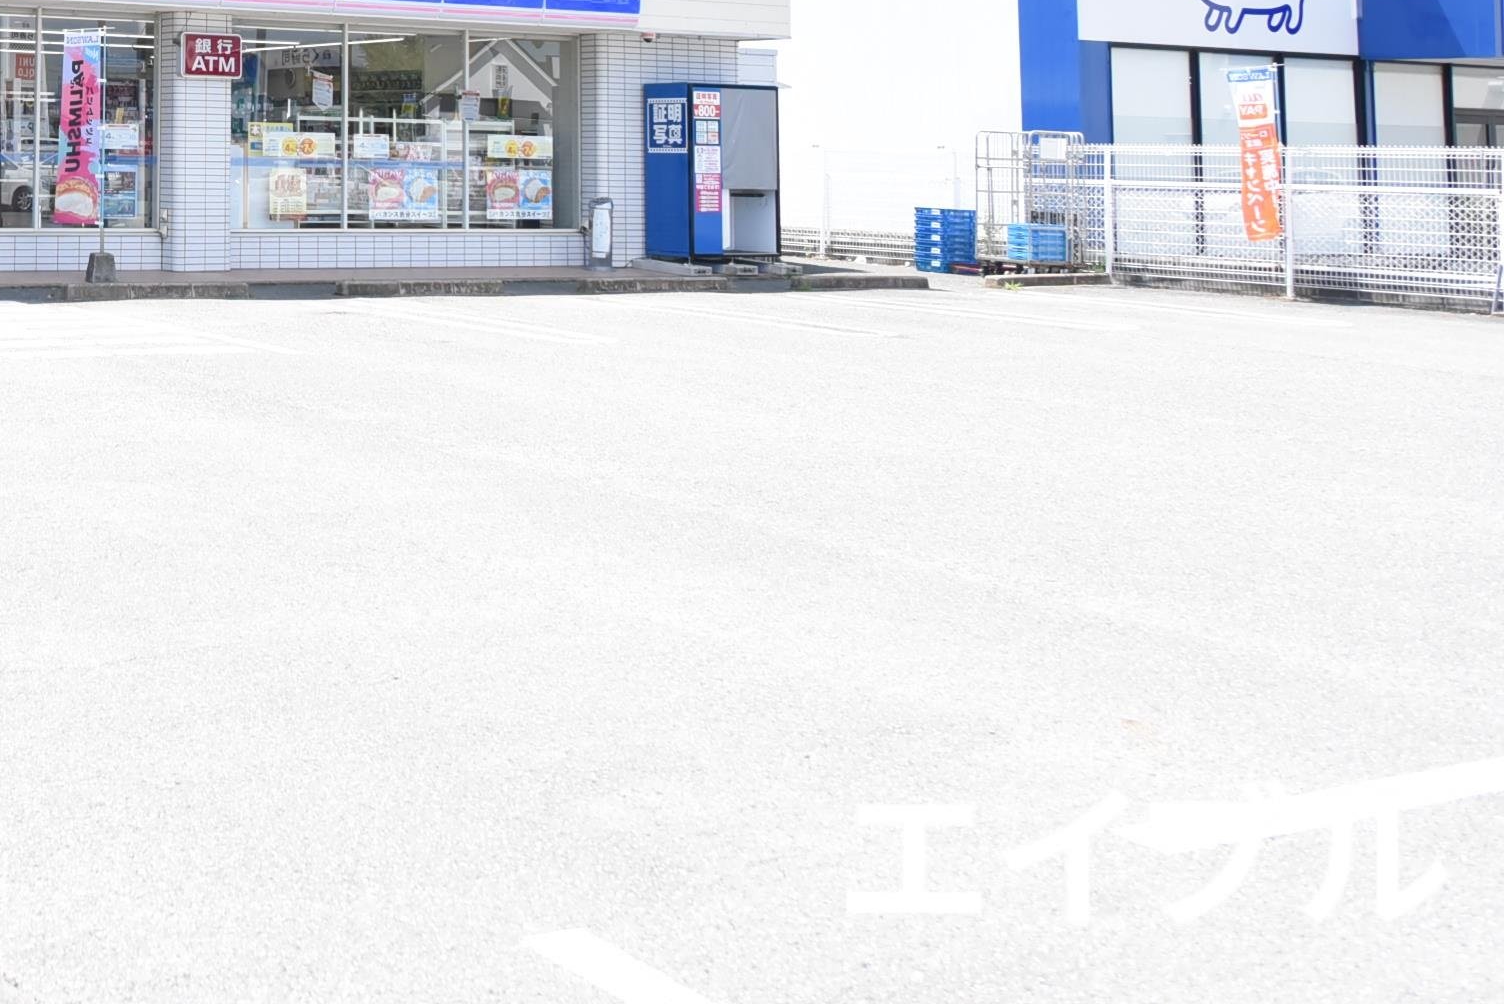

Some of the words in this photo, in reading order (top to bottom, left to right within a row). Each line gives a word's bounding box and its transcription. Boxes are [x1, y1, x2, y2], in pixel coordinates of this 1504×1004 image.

[195, 38, 232, 54] 銀行
[191, 56, 236, 73] ATM
[652, 103, 682, 123] 証明
[652, 124, 683, 145] 写真
